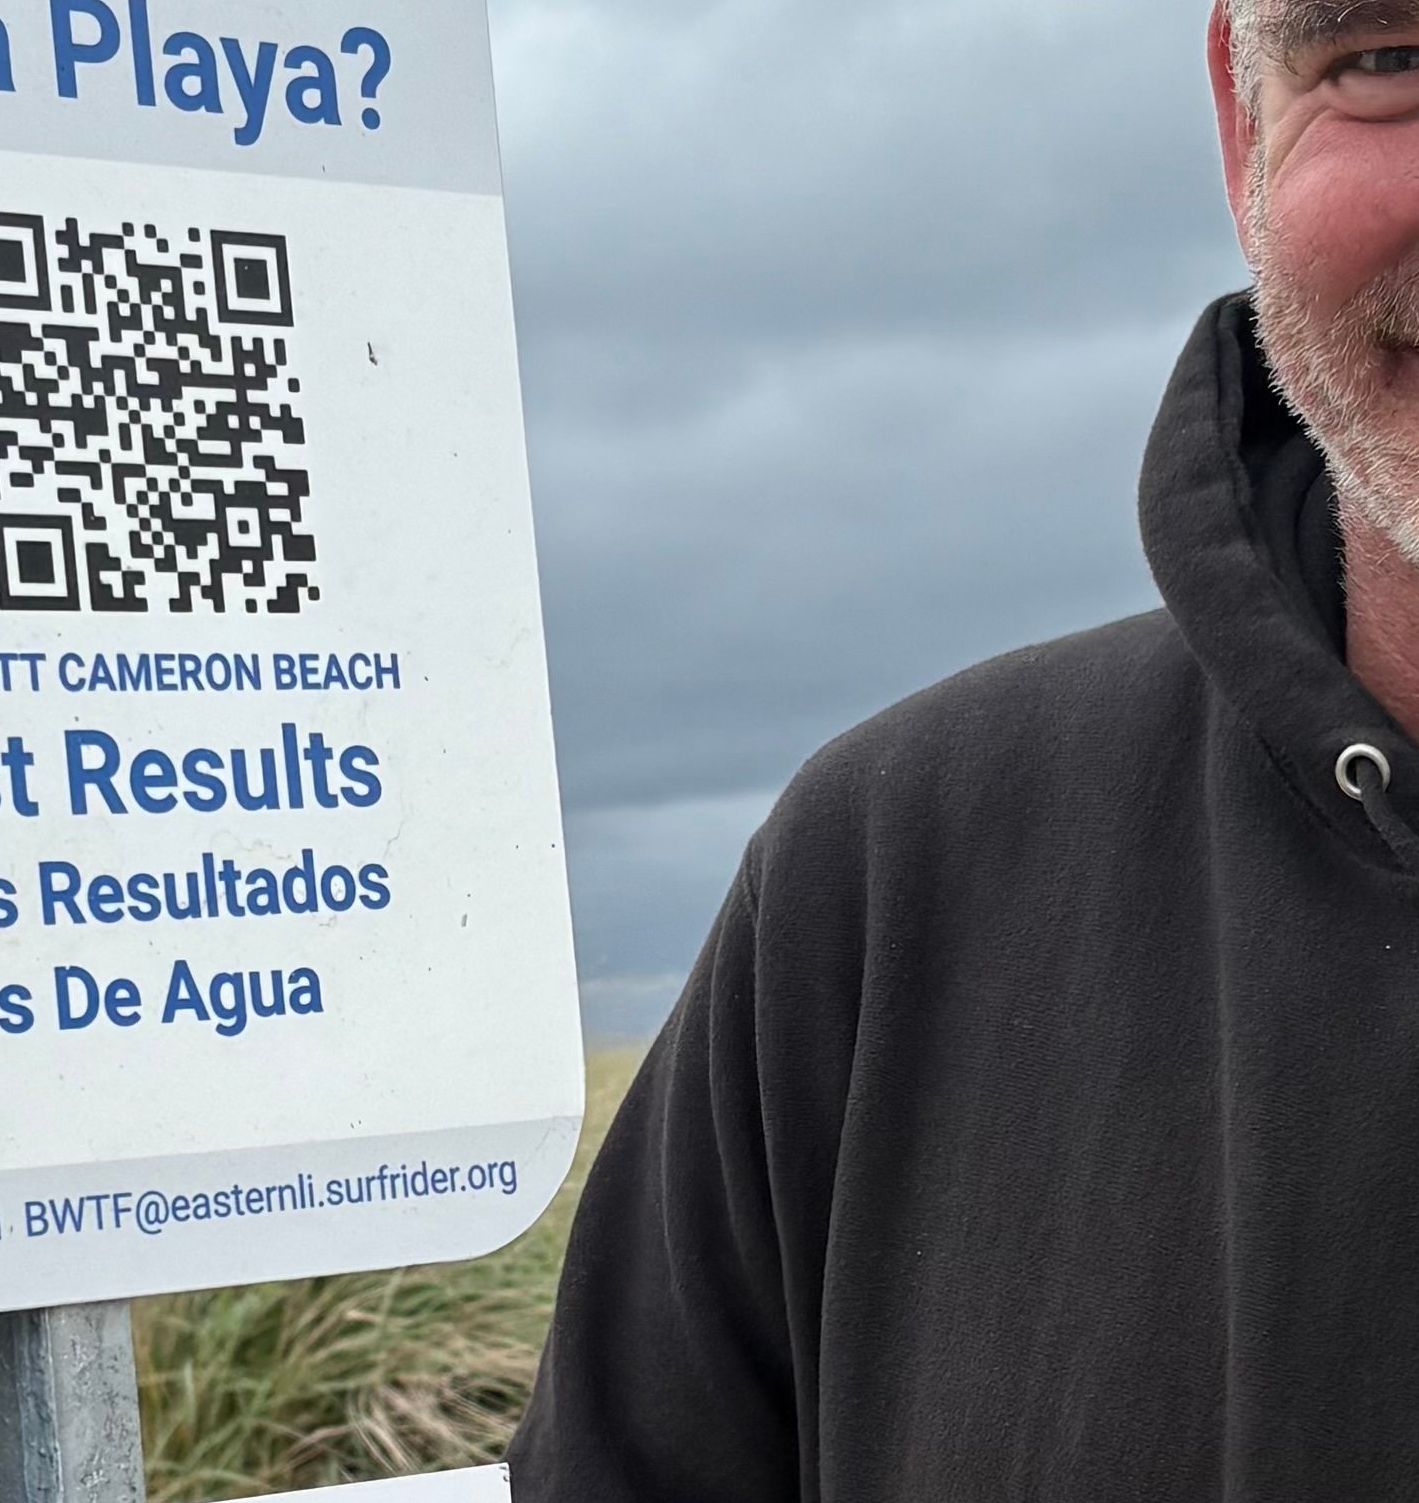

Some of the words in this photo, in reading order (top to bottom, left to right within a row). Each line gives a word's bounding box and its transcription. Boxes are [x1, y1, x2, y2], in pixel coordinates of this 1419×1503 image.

[59, 653, 261, 692] CAMERON
[273, 654, 399, 690] BEACH
[64, 723, 381, 815] Results
[39, 849, 389, 925] Resultados
[54, 967, 140, 1030] De
[162, 961, 322, 1037] Agua
[25, 1163, 519, 1238] BWTF@easternli.surfrider.org
